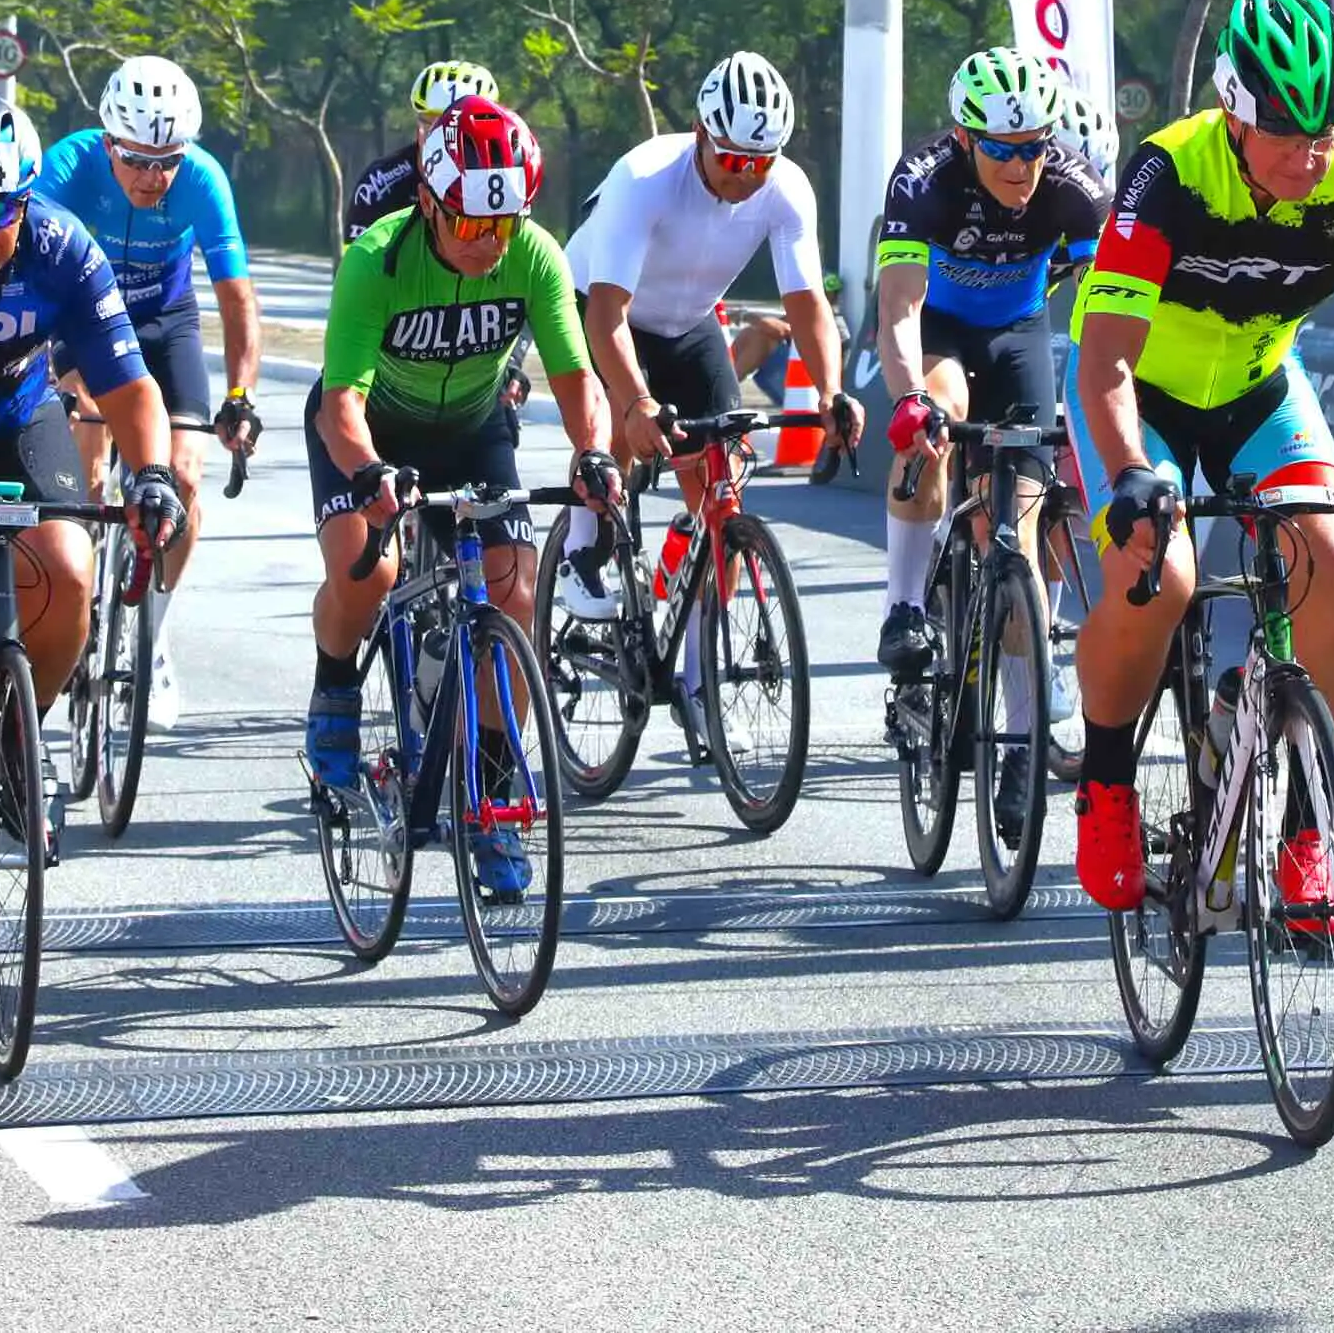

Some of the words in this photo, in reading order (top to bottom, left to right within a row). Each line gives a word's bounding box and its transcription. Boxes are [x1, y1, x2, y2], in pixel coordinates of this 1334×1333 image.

[149, 116, 176, 145] 17
[750, 111, 767, 141] 2
[1006, 95, 1024, 130] 3
[487, 173, 505, 211] 8
[1123, 156, 1165, 209] MASOTTI
[391, 301, 519, 351] VOLARE
